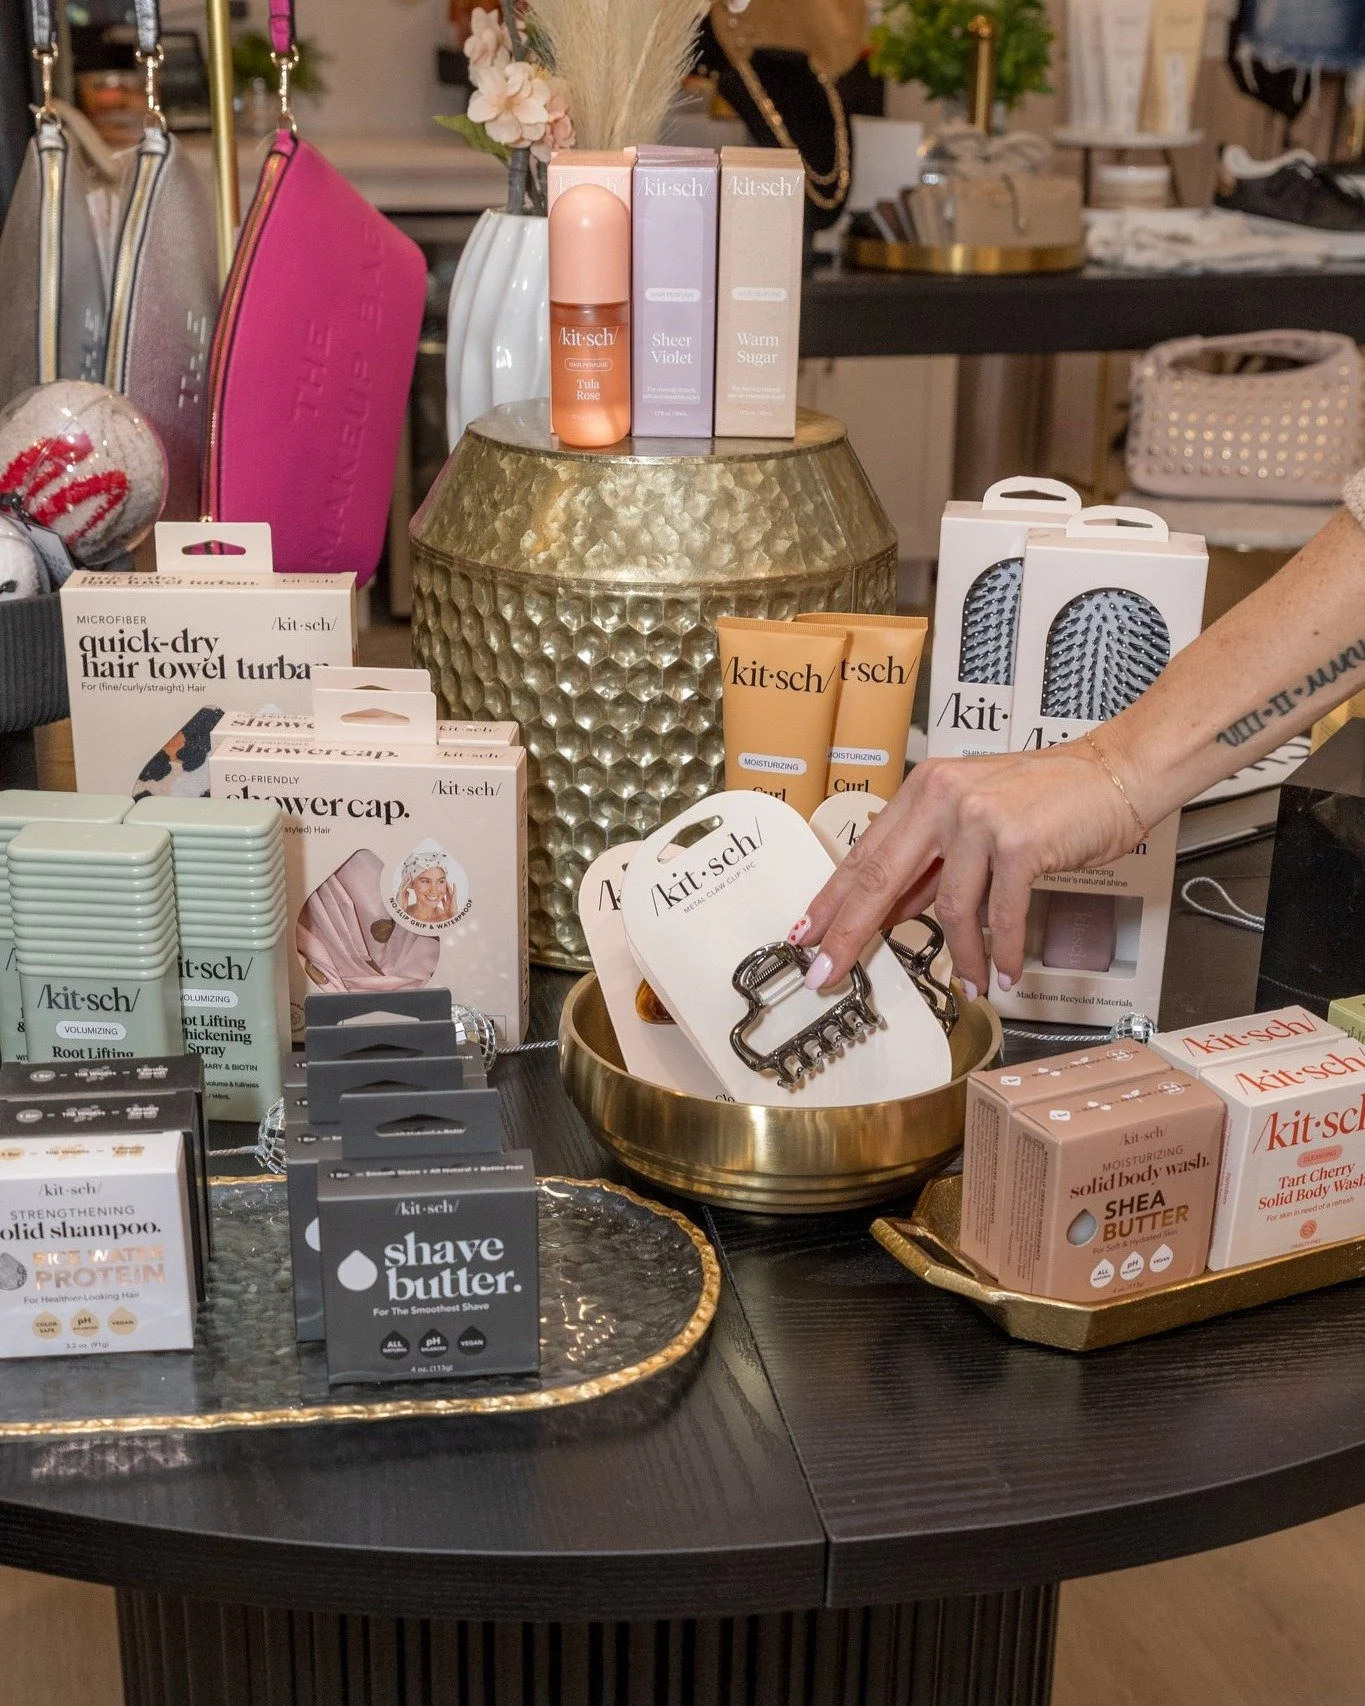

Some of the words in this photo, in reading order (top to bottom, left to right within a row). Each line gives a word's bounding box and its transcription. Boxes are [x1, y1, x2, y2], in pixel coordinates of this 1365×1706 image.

[638, 176, 710, 197] /kit·sch/
[726, 175, 800, 197] /kit·sch/
[558, 326, 619, 347] /kit·sch/
[652, 332, 692, 347] Sheer
[737, 332, 779, 347] Warm
[651, 350, 692, 364] Violet
[737, 350, 778, 366] Sugar
[577, 379, 600, 389] Tula
[577, 390, 600, 400] Rose
[76, 615, 147, 625] MICROFIBER
[271, 617, 338, 632] /kit·sch/
[79, 628, 220, 662] quick-dry
[81, 653, 139, 679] hair
[149, 654, 228, 680] towel
[236, 654, 330, 681] turba
[722, 656, 837, 694] /kit·sch/
[840, 655, 917, 685] t·sch/
[81, 682, 96, 691] For
[99, 682, 185, 695] (fine/curly/straight)
[187, 683, 206, 692] Hair
[936, 692, 1009, 732] /kit·
[340, 749, 399, 759] cap.
[743, 757, 799, 771] MOISTURIZING
[225, 774, 300, 785] ECO-FRIENDLY
[834, 778, 869, 793] Curl
[432, 780, 502, 796] /kit·sch/
[226, 785, 343, 817] ower
[347, 798, 410, 825] cap.
[284, 826, 312, 834] styled)
[314, 826, 331, 834] Hair
[650, 816, 763, 917] /kit·sch/
[1079, 878, 1105, 886] natural
[683, 896, 707, 914] METAL
[706, 881, 726, 898] CLAW
[726, 871, 741, 884] CLIP
[389, 897, 409, 921] NO-SLIP
[410, 919, 427, 929] GRIP
[436, 898, 473, 930] WATERPROOF
[178, 955, 254, 981] it·sch/
[37, 983, 141, 1013] /kit·sch/
[1016, 991, 1038, 1000] Made
[1039, 992, 1058, 1001] from
[1060, 994, 1095, 1005] Recycled
[1096, 998, 1133, 1007] Materials
[200, 1015, 246, 1030] Lifting
[64, 1026, 119, 1036] VOLUMIZING
[1181, 1012, 1318, 1058] /kit·sch/
[52, 1046, 84, 1059] Root
[188, 1043, 226, 1058] Spray
[1102, 1145, 1184, 1172] MOISTURIZING
[1070, 1173, 1115, 1199] solid
[1118, 1164, 1161, 1188] body
[1165, 1151, 1210, 1176] wash.
[1279, 1173, 1306, 1190] Tart
[1309, 1163, 1355, 1182] Cherry
[38, 1181, 102, 1197] /kit·sch/
[1258, 1190, 1293, 1210] Solid
[1296, 1184, 1331, 1202] Body
[394, 1199, 460, 1216] /kit·sch/
[1104, 1189, 1166, 1220] SHEA
[1266, 1214, 1277, 1222] For
[1279, 1210, 1293, 1219] skin
[1301, 1206, 1317, 1215] need
[1318, 1203, 1326, 1211] of
[10, 1205, 136, 1221] STRENGTHENING
[0, 1221, 45, 1241] olid
[50, 1221, 162, 1240] shampoo.
[1103, 1204, 1189, 1243] BUTTER
[32, 1250, 81, 1265] RICE
[88, 1247, 165, 1263] WATER
[384, 1231, 505, 1267] shave
[1092, 1247, 1105, 1255] For
[1127, 1259, 1139, 1269] pH
[1153, 1256, 1170, 1264] VEGAN
[35, 1263, 166, 1291] PROTEIN
[386, 1267, 522, 1301] butter.
[24, 1296, 39, 1304] For
[373, 1308, 389, 1316] For
[391, 1307, 408, 1316] The
[411, 1305, 460, 1315] Smoothest
[462, 1303, 490, 1311] Shave
[78, 1317, 91, 1325] pH
[426, 1337, 441, 1347] pH
